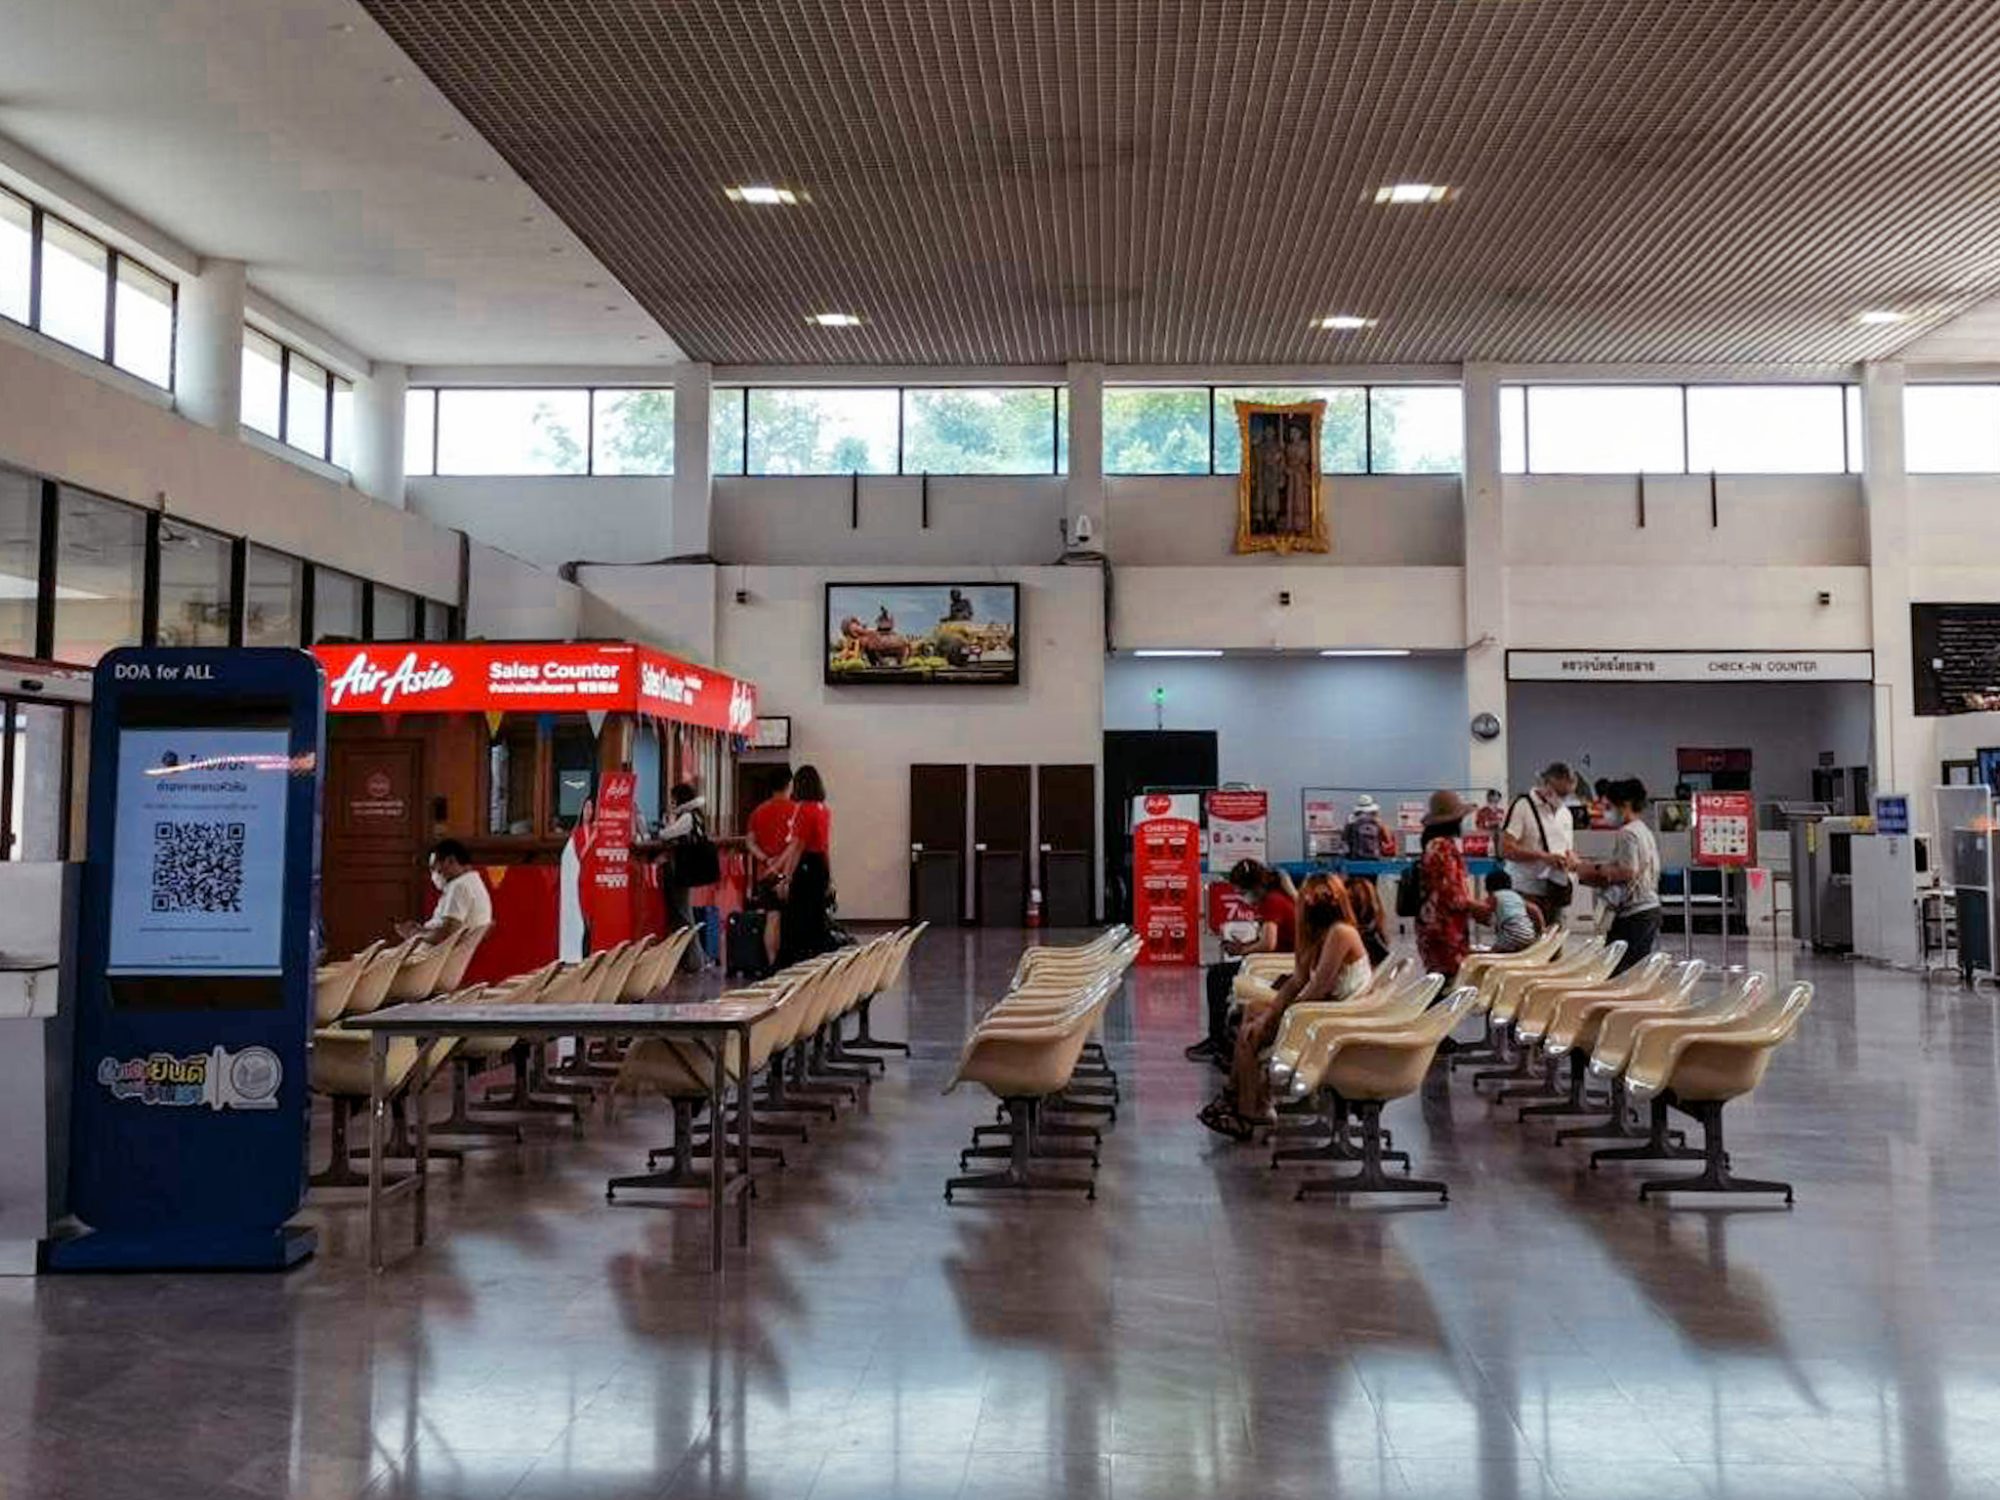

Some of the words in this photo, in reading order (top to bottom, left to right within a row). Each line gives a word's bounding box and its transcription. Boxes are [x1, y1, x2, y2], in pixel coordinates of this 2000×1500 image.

[114, 664, 151, 680] DOA
[157, 664, 179, 680] for
[184, 664, 215, 680] ALL
[489, 661, 539, 679] Sales
[543, 661, 620, 679] Counter
[1708, 660, 1762, 672] CHECK-IN
[1767, 660, 1818, 672] COUNTER
